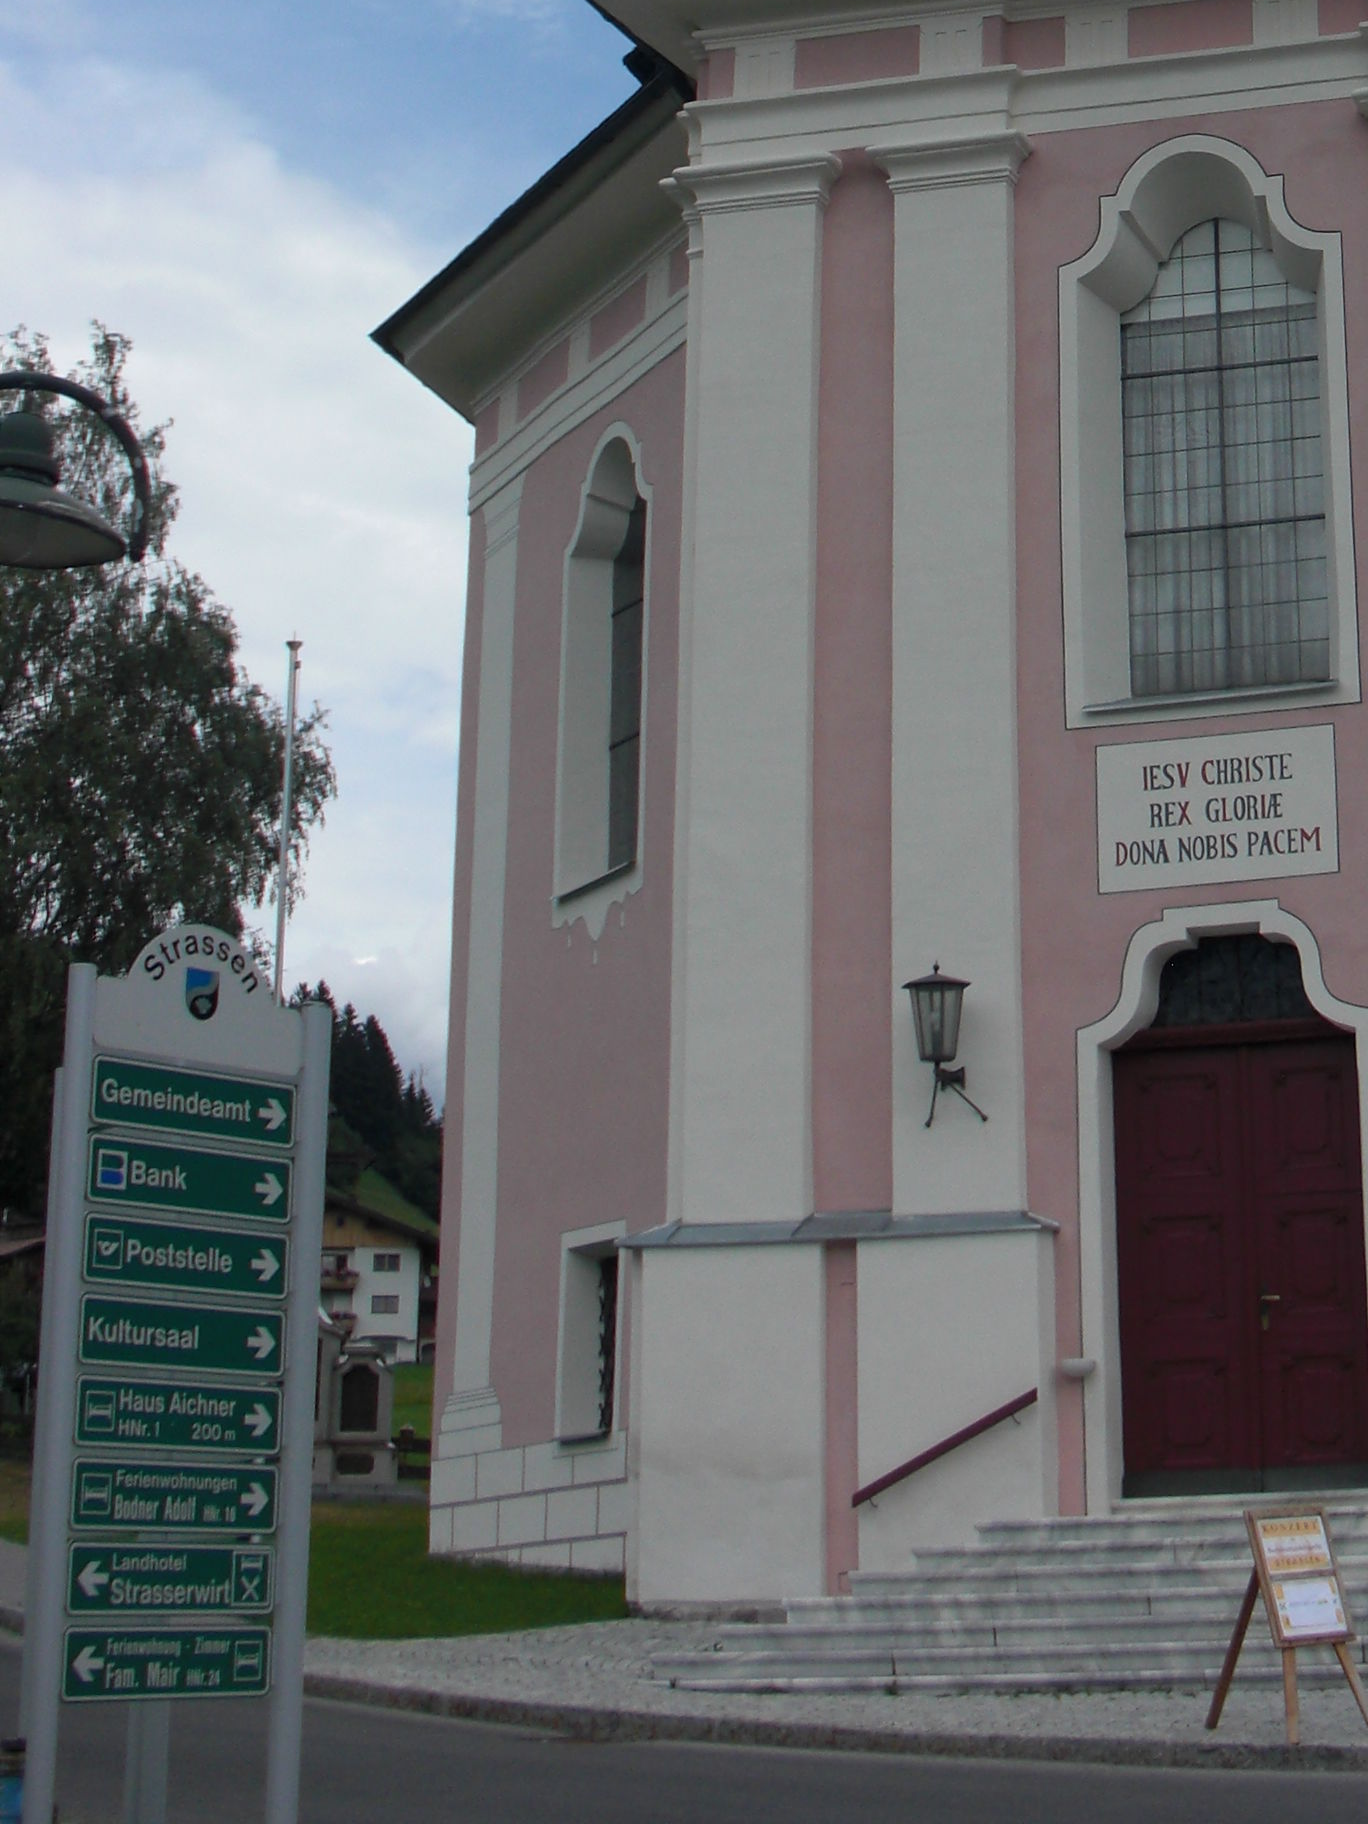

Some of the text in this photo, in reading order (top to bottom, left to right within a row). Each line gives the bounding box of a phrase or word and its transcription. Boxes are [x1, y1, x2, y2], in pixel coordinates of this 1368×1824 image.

[1142, 753, 1293, 791] IESV CHRISTE
[1149, 793, 1283, 828] REX GLORIÆ
[1115, 826, 1322, 867] DONA NOBIS PACEM
[144, 934, 261, 994] Strassen
[101, 1077, 252, 1123] Gemeindeamt
[131, 1160, 187, 1191] Bank
[126, 1238, 233, 1274] Poststelle
[88, 1316, 199, 1351] Kultursaal
[119, 1388, 236, 1417] Haus Aichner
[118, 1419, 150, 1437] HNr.
[192, 1424, 221, 1441] 200
[224, 1429, 236, 1442] m
[115, 1470, 237, 1494] Ferienwohnungen
[114, 1494, 159, 1520] Bodner
[164, 1495, 196, 1521] Adolf
[112, 1553, 187, 1571] Landhotel
[110, 1578, 231, 1605] Strasserwirt
[195, 1635, 230, 1654] Zimmer
[105, 1662, 139, 1688] Fam.
[147, 1661, 180, 1687] Mair
